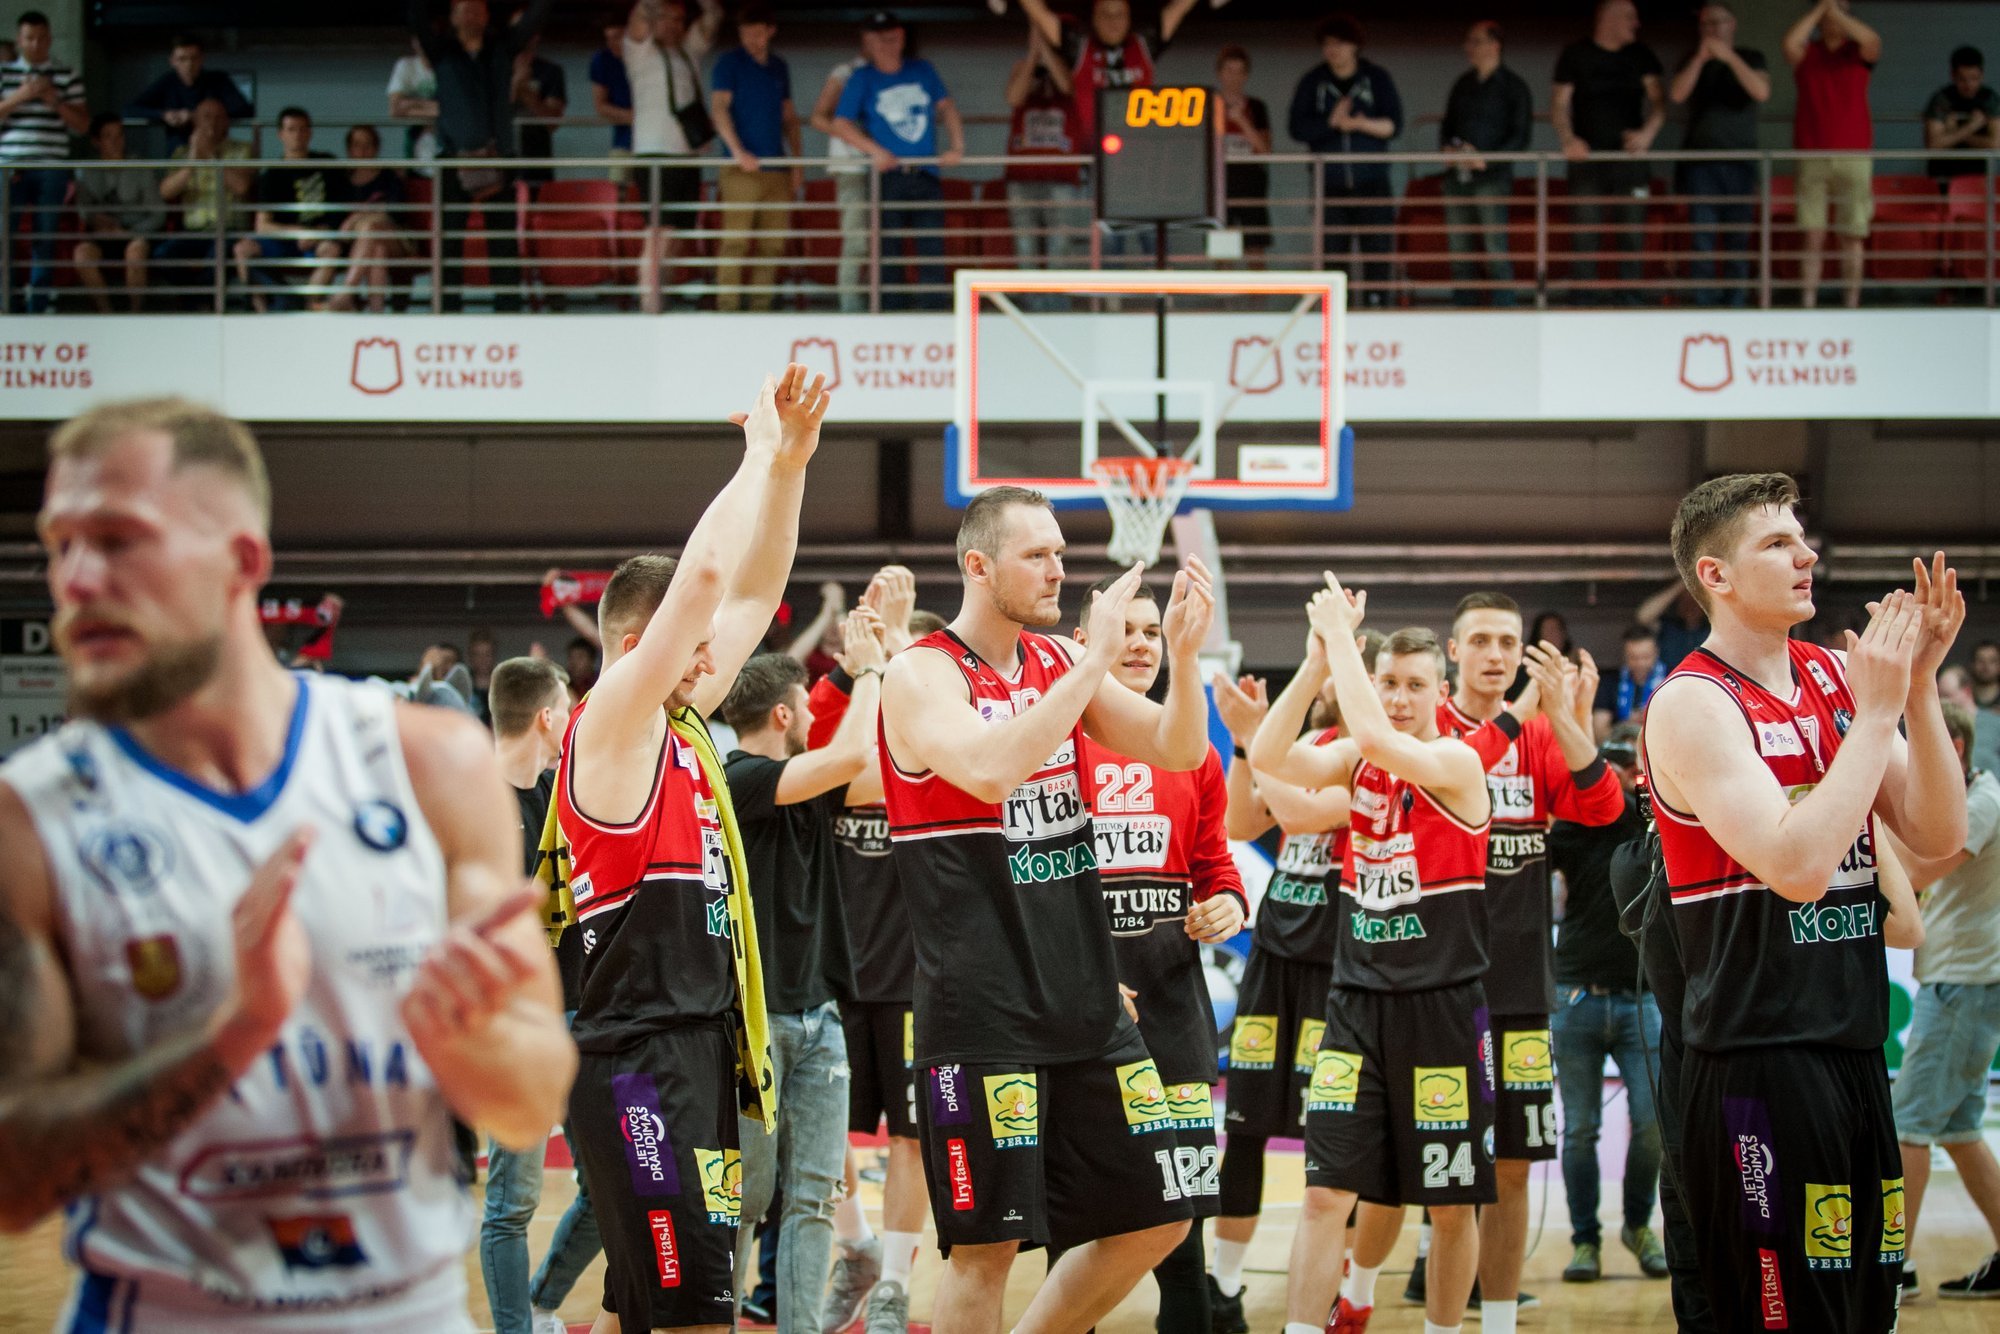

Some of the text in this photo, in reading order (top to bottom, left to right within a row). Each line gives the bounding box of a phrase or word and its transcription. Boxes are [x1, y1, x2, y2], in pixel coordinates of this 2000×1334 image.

[1126, 88, 1206, 127] 0:00
[0, 343, 89, 363] ITY OF
[414, 344, 518, 362] CITY OF
[852, 344, 914, 362] CITY
[1367, 342, 1401, 361] OF
[1746, 340, 1852, 359] CITY OF
[0, 369, 93, 388] ILNIUS
[416, 371, 523, 388] VILNIUS
[1297, 369, 1407, 387] VINIUS
[1747, 367, 1858, 384] VILNIUS
[1095, 763, 1154, 812] 22
[1493, 858, 1514, 868] 1784
[1114, 917, 1145, 928] 1784
[1415, 1121, 1468, 1130] PERLAS
[626, 1105, 649, 1168] LIETUVOS
[636, 1106, 664, 1181] DRAUDIMAS
[1423, 1142, 1476, 1189] 24
[1738, 1134, 1759, 1202] LIETUVOS
[1746, 1134, 1770, 1219] DRAUDIMAS
[1809, 1258, 1851, 1269] PERL
